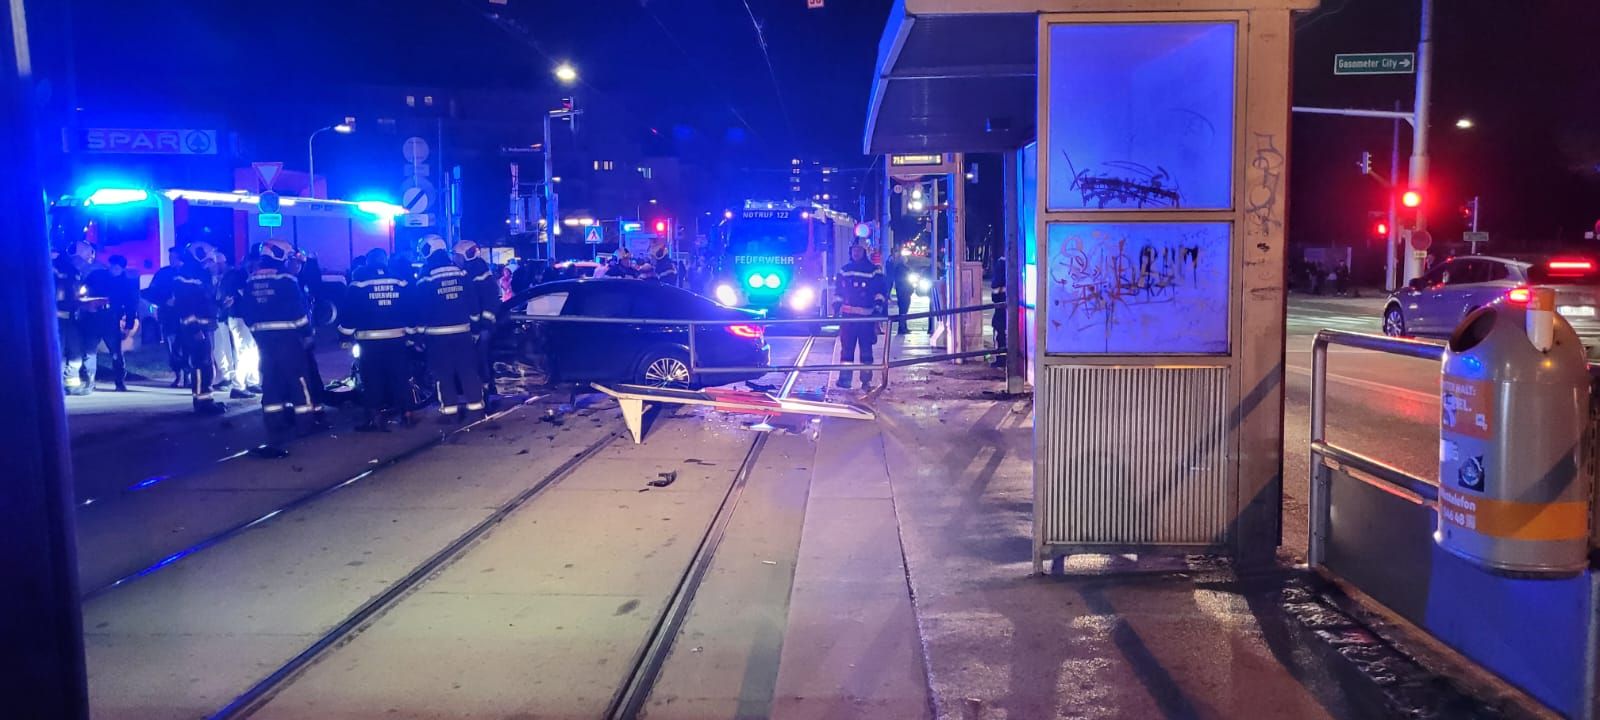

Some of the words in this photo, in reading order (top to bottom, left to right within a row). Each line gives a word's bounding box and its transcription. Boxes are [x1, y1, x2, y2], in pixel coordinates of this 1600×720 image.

[1338, 59, 1379, 69] Gasometer
[1382, 58, 1398, 69] City
[88, 132, 179, 149] SPAR
[743, 211, 774, 219] NOTRUF
[777, 211, 789, 219] 122
[735, 255, 795, 265] FEUERWEHR
